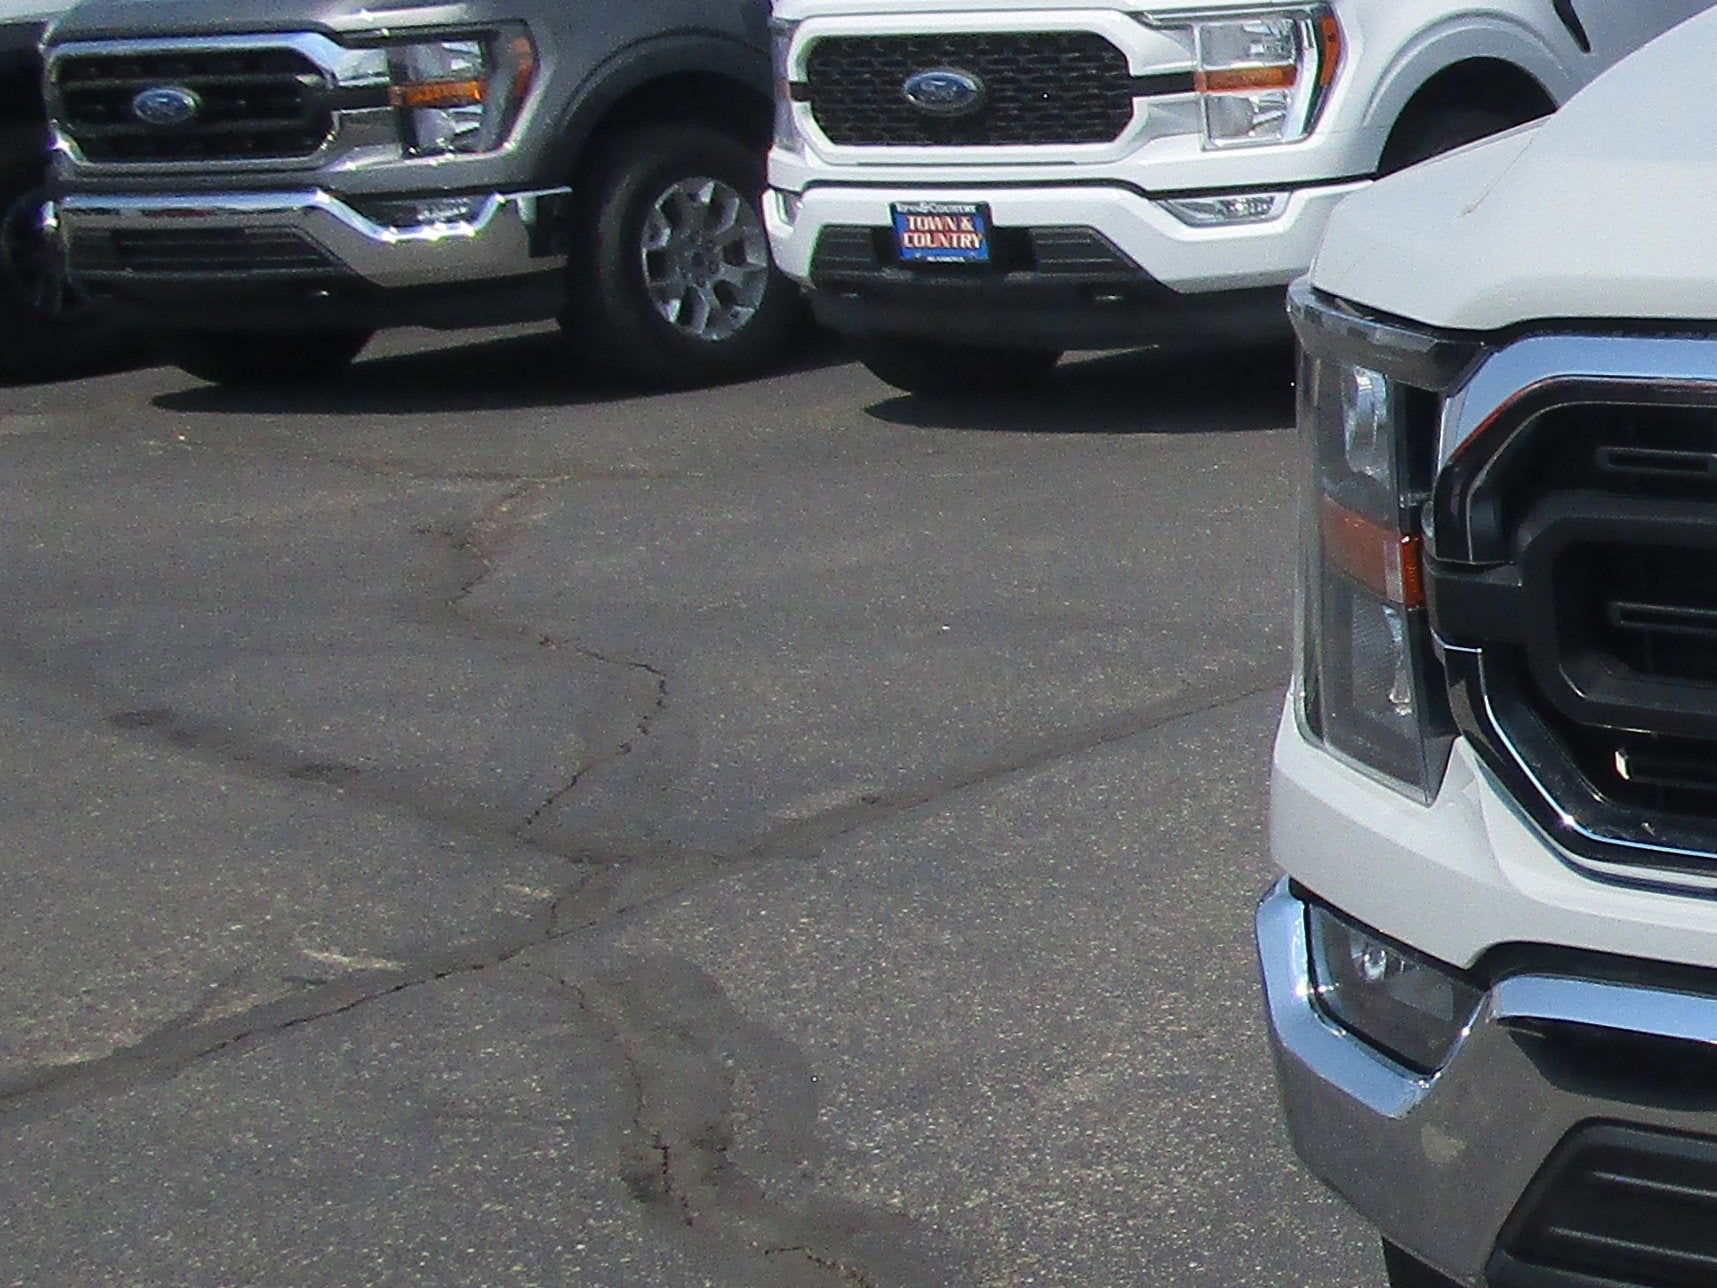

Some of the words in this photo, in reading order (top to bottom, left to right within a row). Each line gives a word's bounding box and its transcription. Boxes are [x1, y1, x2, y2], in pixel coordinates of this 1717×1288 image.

[906, 215, 957, 232] TOWN
[959, 215, 976, 232] &
[902, 232, 983, 249] COUNTRY
